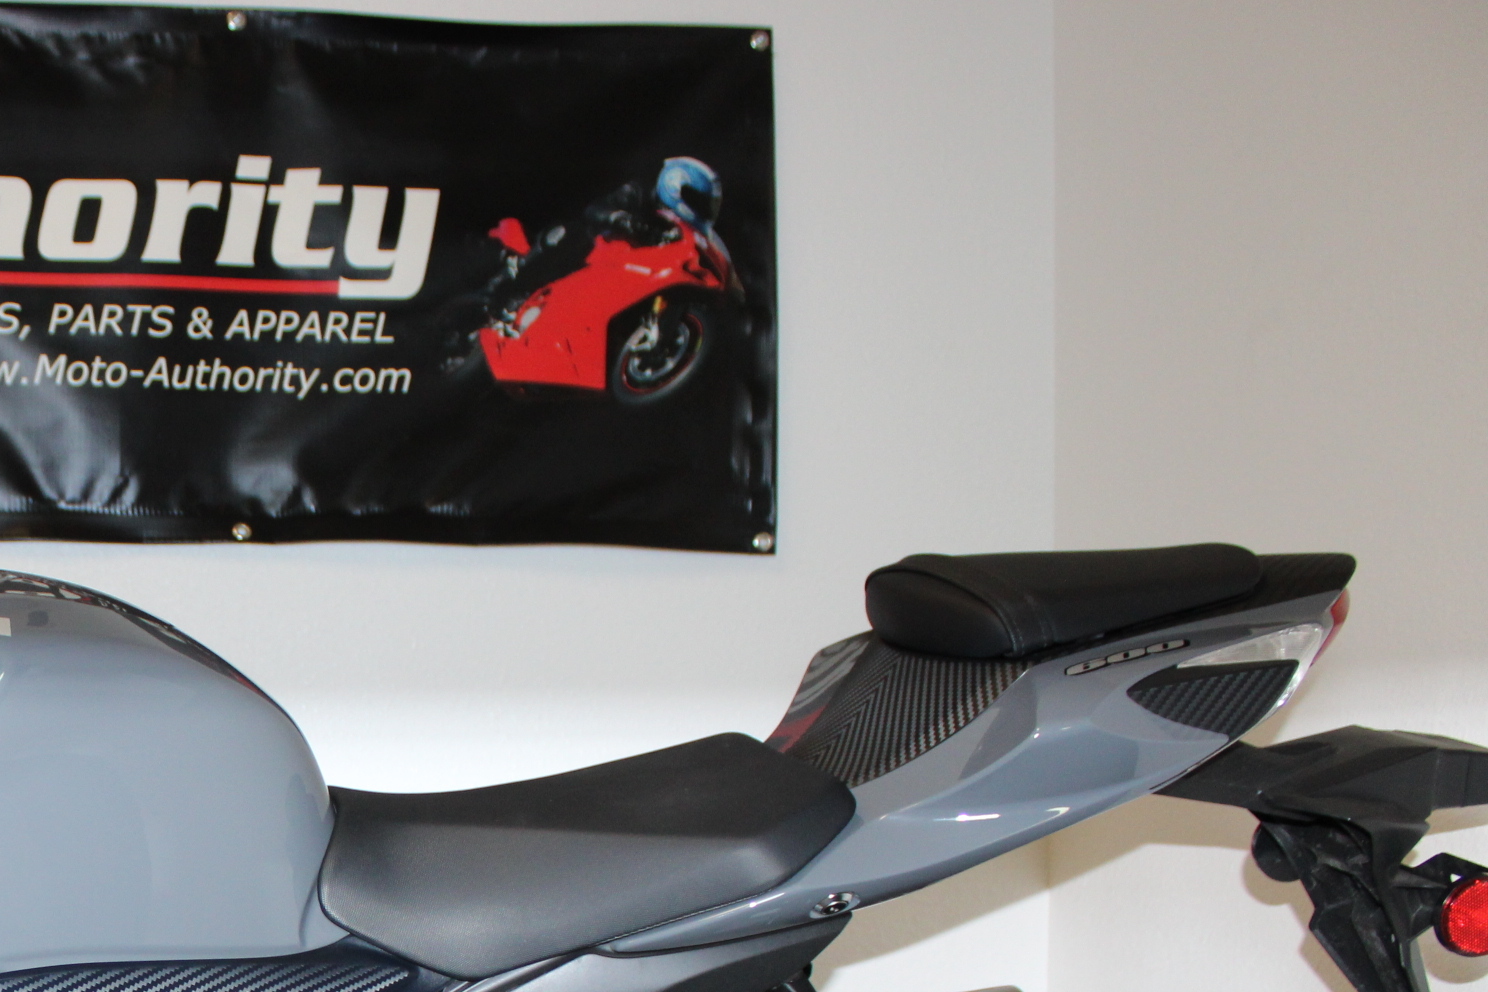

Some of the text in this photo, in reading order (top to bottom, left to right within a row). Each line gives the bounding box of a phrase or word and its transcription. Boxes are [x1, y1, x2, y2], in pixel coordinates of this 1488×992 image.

[48, 303, 175, 339] PARTS
[186, 307, 213, 340] &
[223, 309, 395, 344] APPAREL
[1064, 639, 1189, 676] 600
